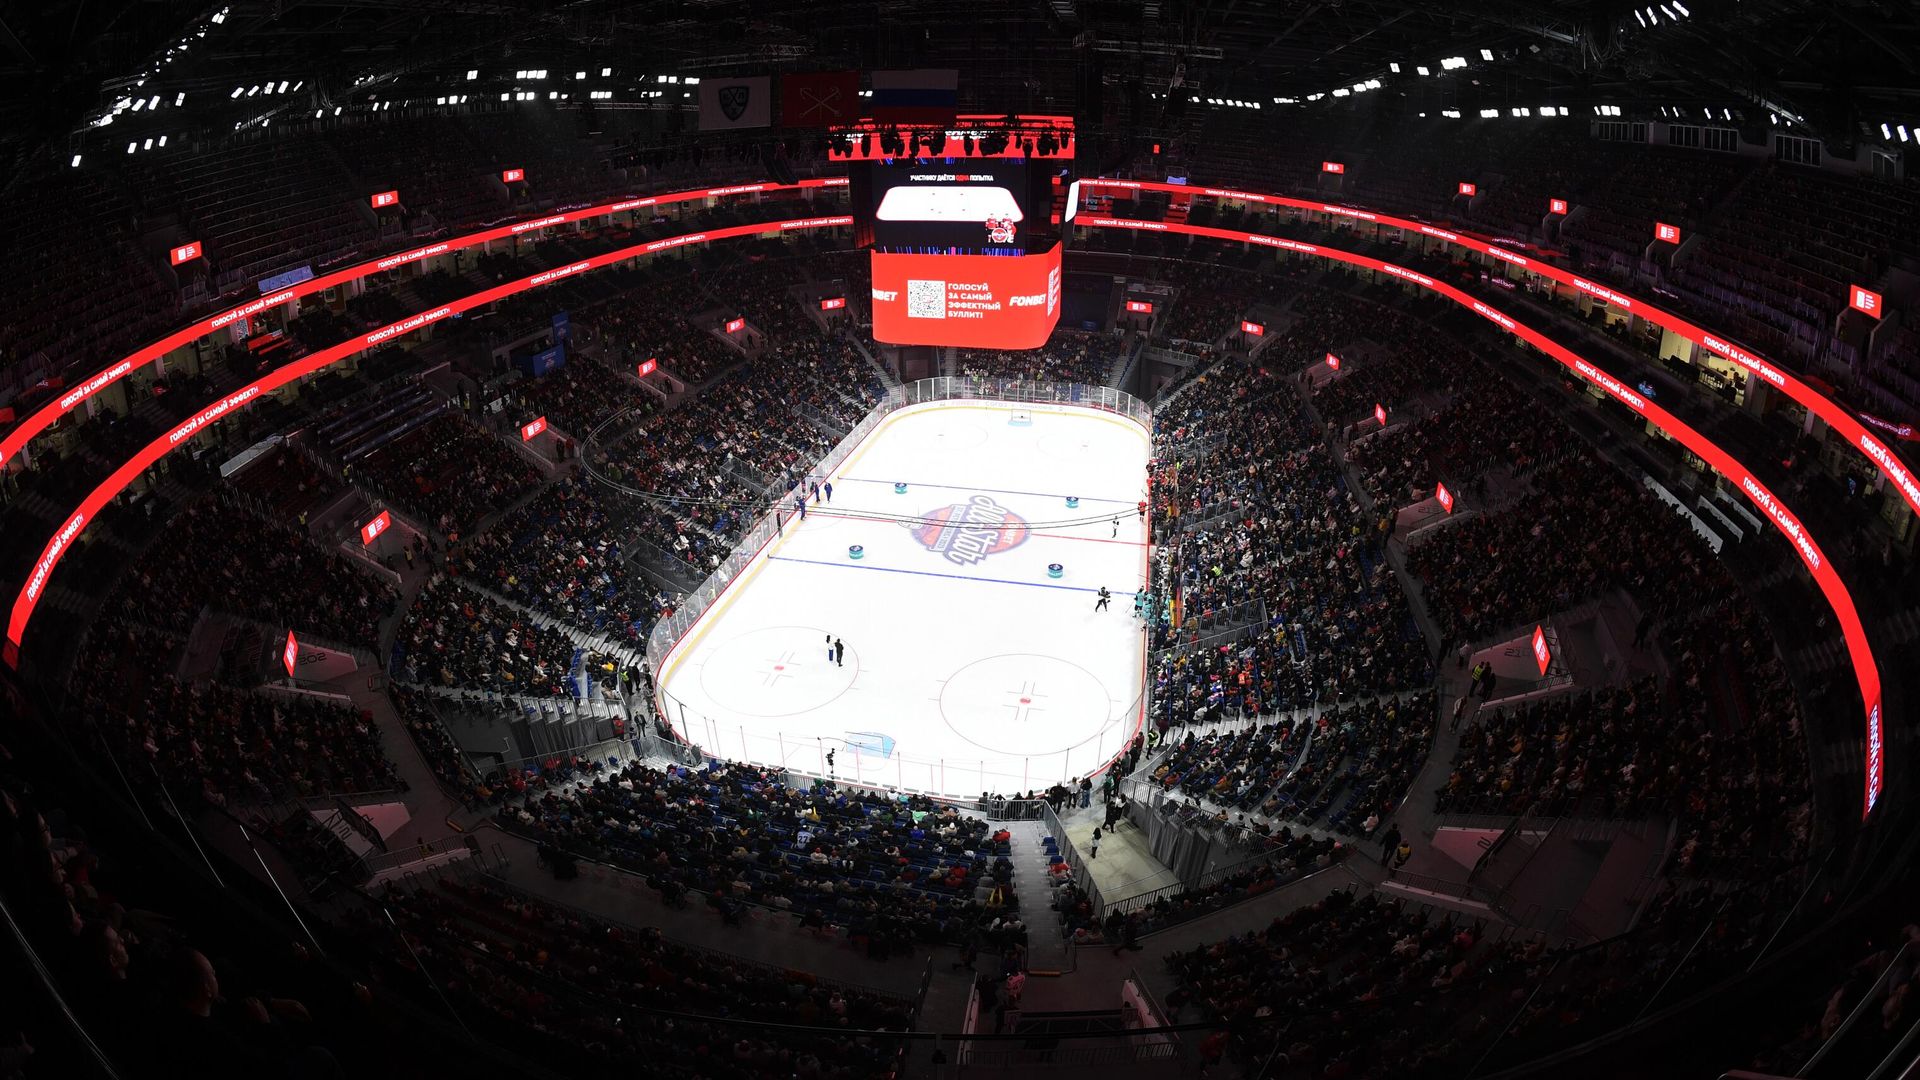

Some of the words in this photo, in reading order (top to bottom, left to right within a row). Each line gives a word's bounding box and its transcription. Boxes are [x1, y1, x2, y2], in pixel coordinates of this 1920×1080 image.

[947, 282, 989, 291] ГОЛОСУЙ
[960, 292, 992, 301] САМЫЙ
[1009, 293, 1047, 307] FONBET
[947, 301, 1001, 310] ЭФФЕКТНЫЙ
[947, 310, 983, 319] БУЛЛИТ!
[1703, 336, 1729, 356] ГОЛОСУЙ
[1738, 351, 1760, 371] САМЫЙ
[1575, 360, 1596, 377] ГОЛОСУЙ
[1602, 377, 1621, 394] САМЫЙ
[169, 418, 197, 443] ГОЛОСУЙ
[205, 400, 229, 420] САМЫЙ
[1743, 476, 1770, 508] ГОЛОСУЙ
[1776, 511, 1800, 539] САМЫЙ
